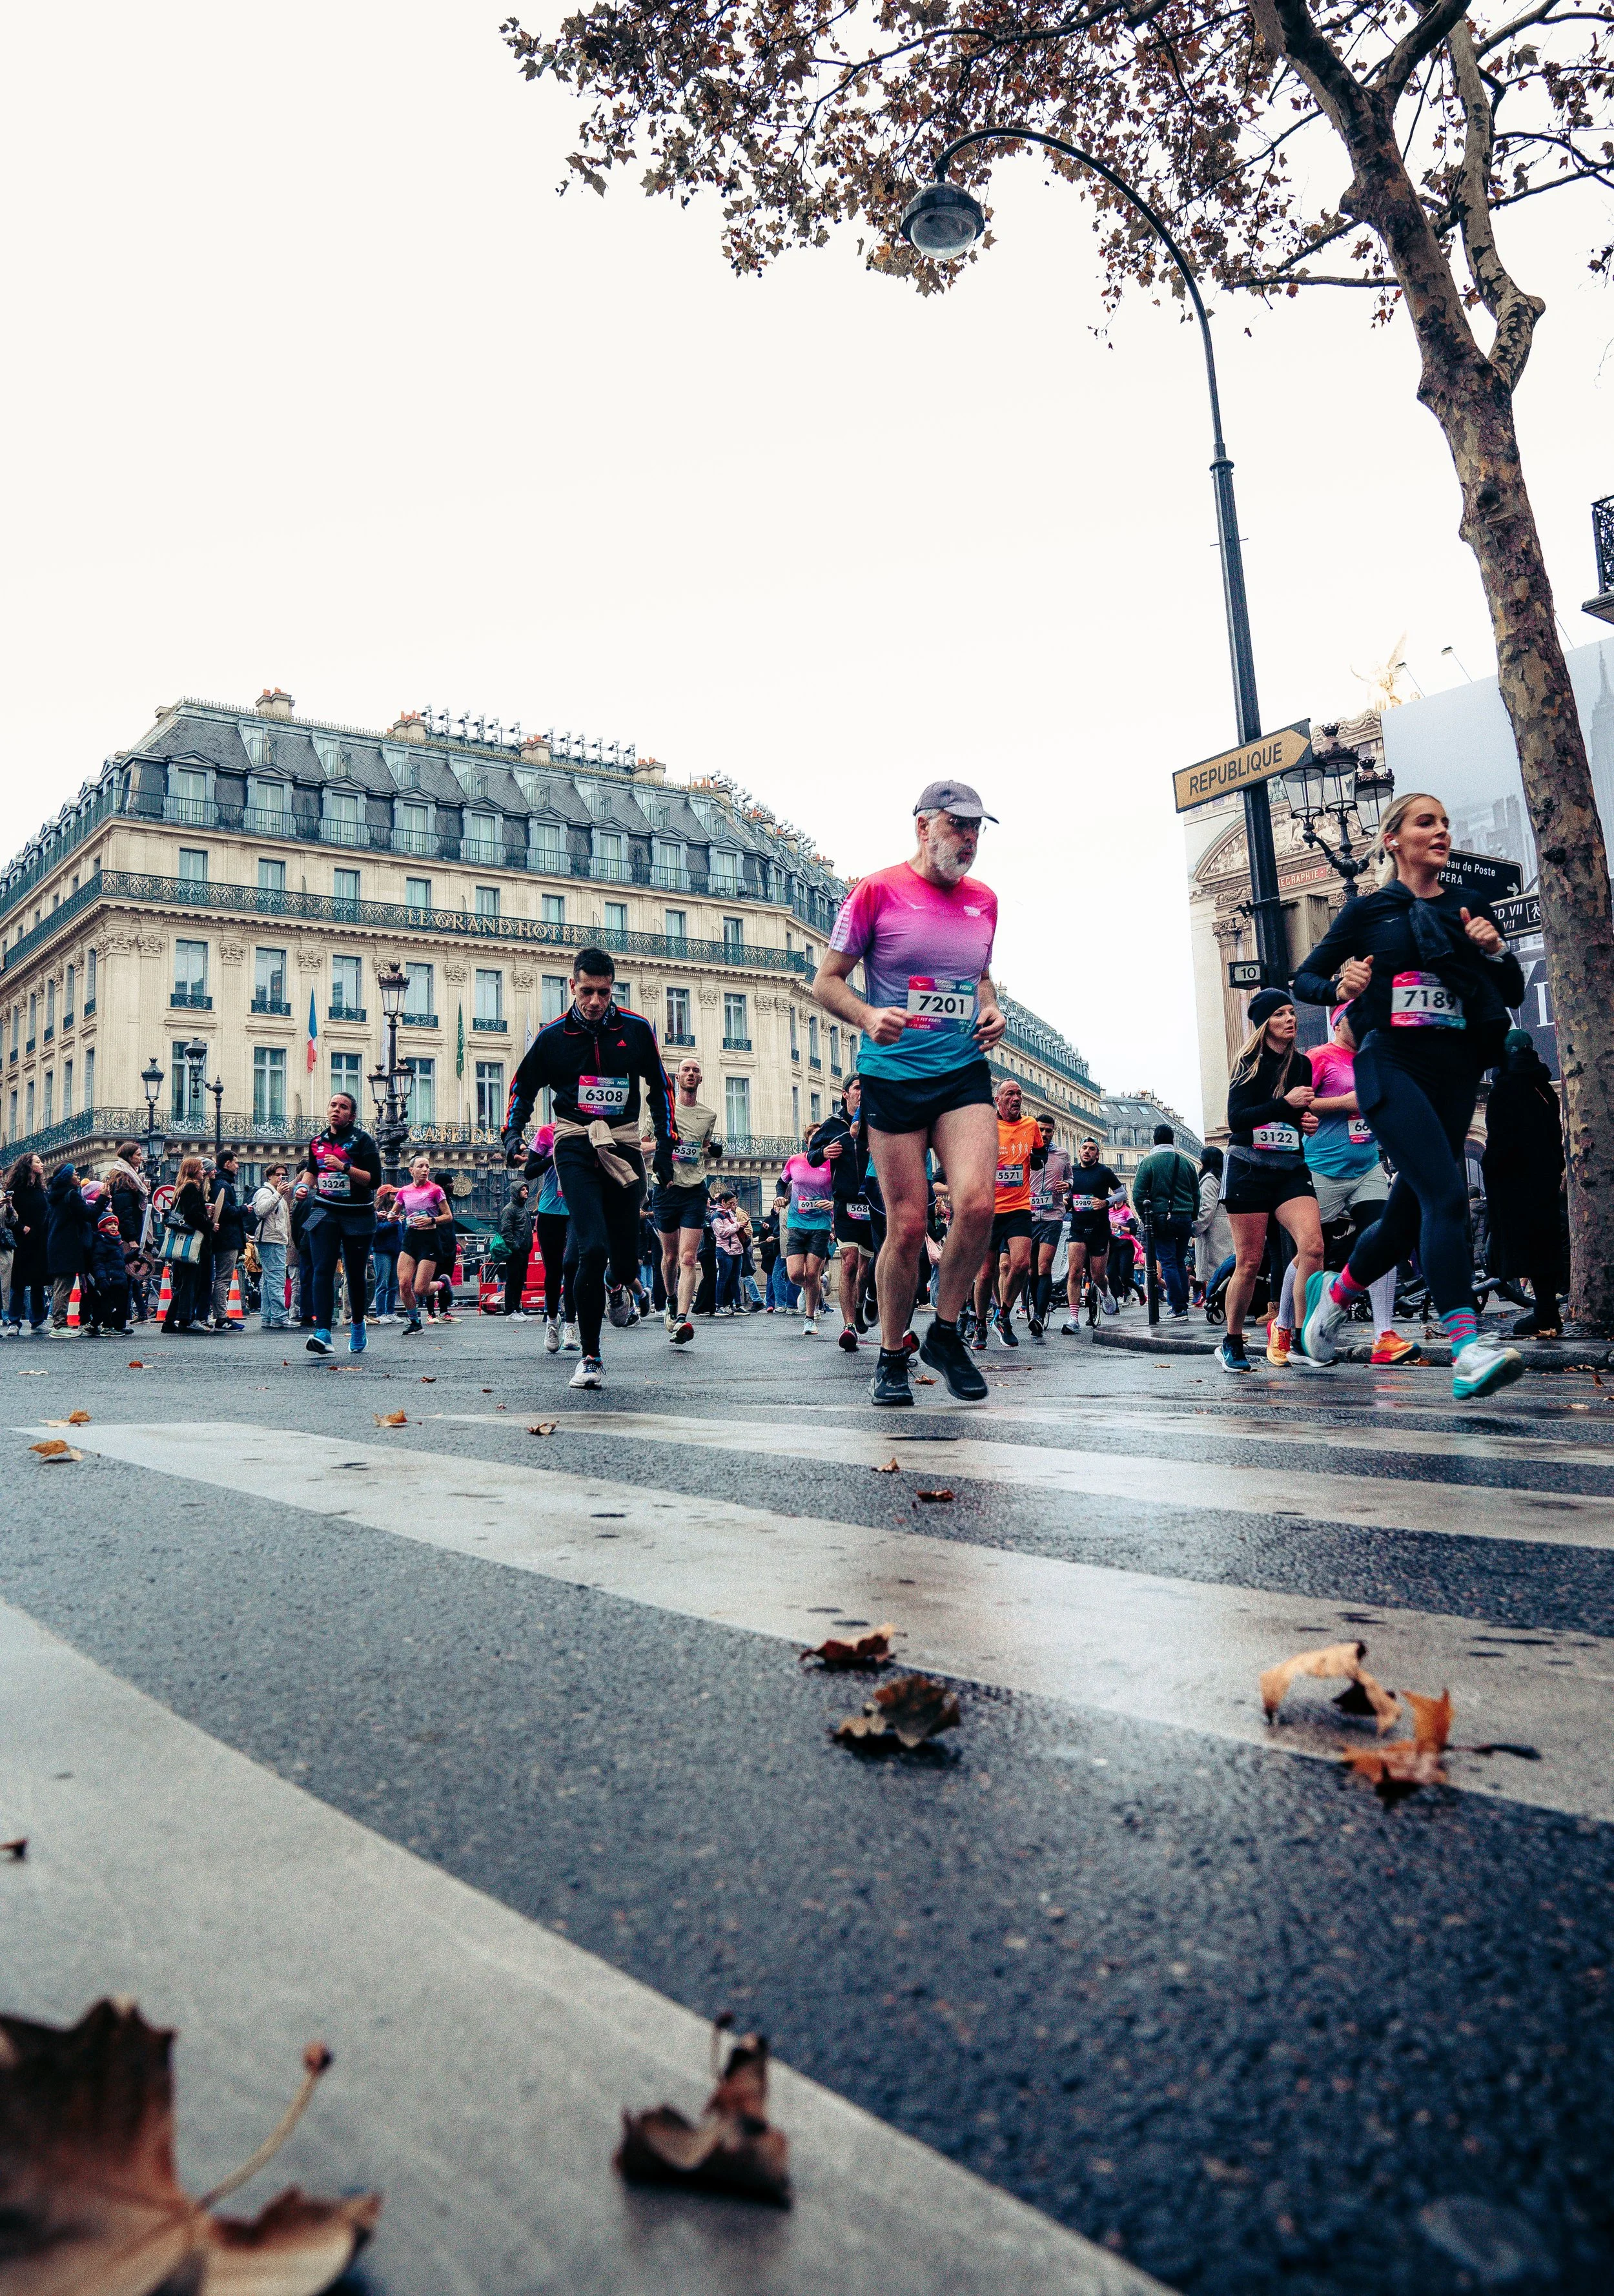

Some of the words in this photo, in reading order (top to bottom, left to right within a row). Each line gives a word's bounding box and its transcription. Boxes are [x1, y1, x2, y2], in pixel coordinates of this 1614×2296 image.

[1190, 742, 1282, 796] REPUBLIQUE
[1462, 862, 1472, 872] de
[1474, 864, 1496, 877] Poste
[1509, 903, 1522, 916] VII
[407, 909, 428, 926] LE
[434, 914, 512, 934] GRAND
[518, 924, 582, 943] HOTEL
[1241, 967, 1256, 978] 10
[918, 995, 965, 1014] 7201
[1404, 990, 1456, 1010] 7189
[586, 1089, 623, 1103] 6308
[470, 1128, 496, 1144] DE
[1260, 1131, 1293, 1143] 3122
[675, 1147, 697, 1156] 6539
